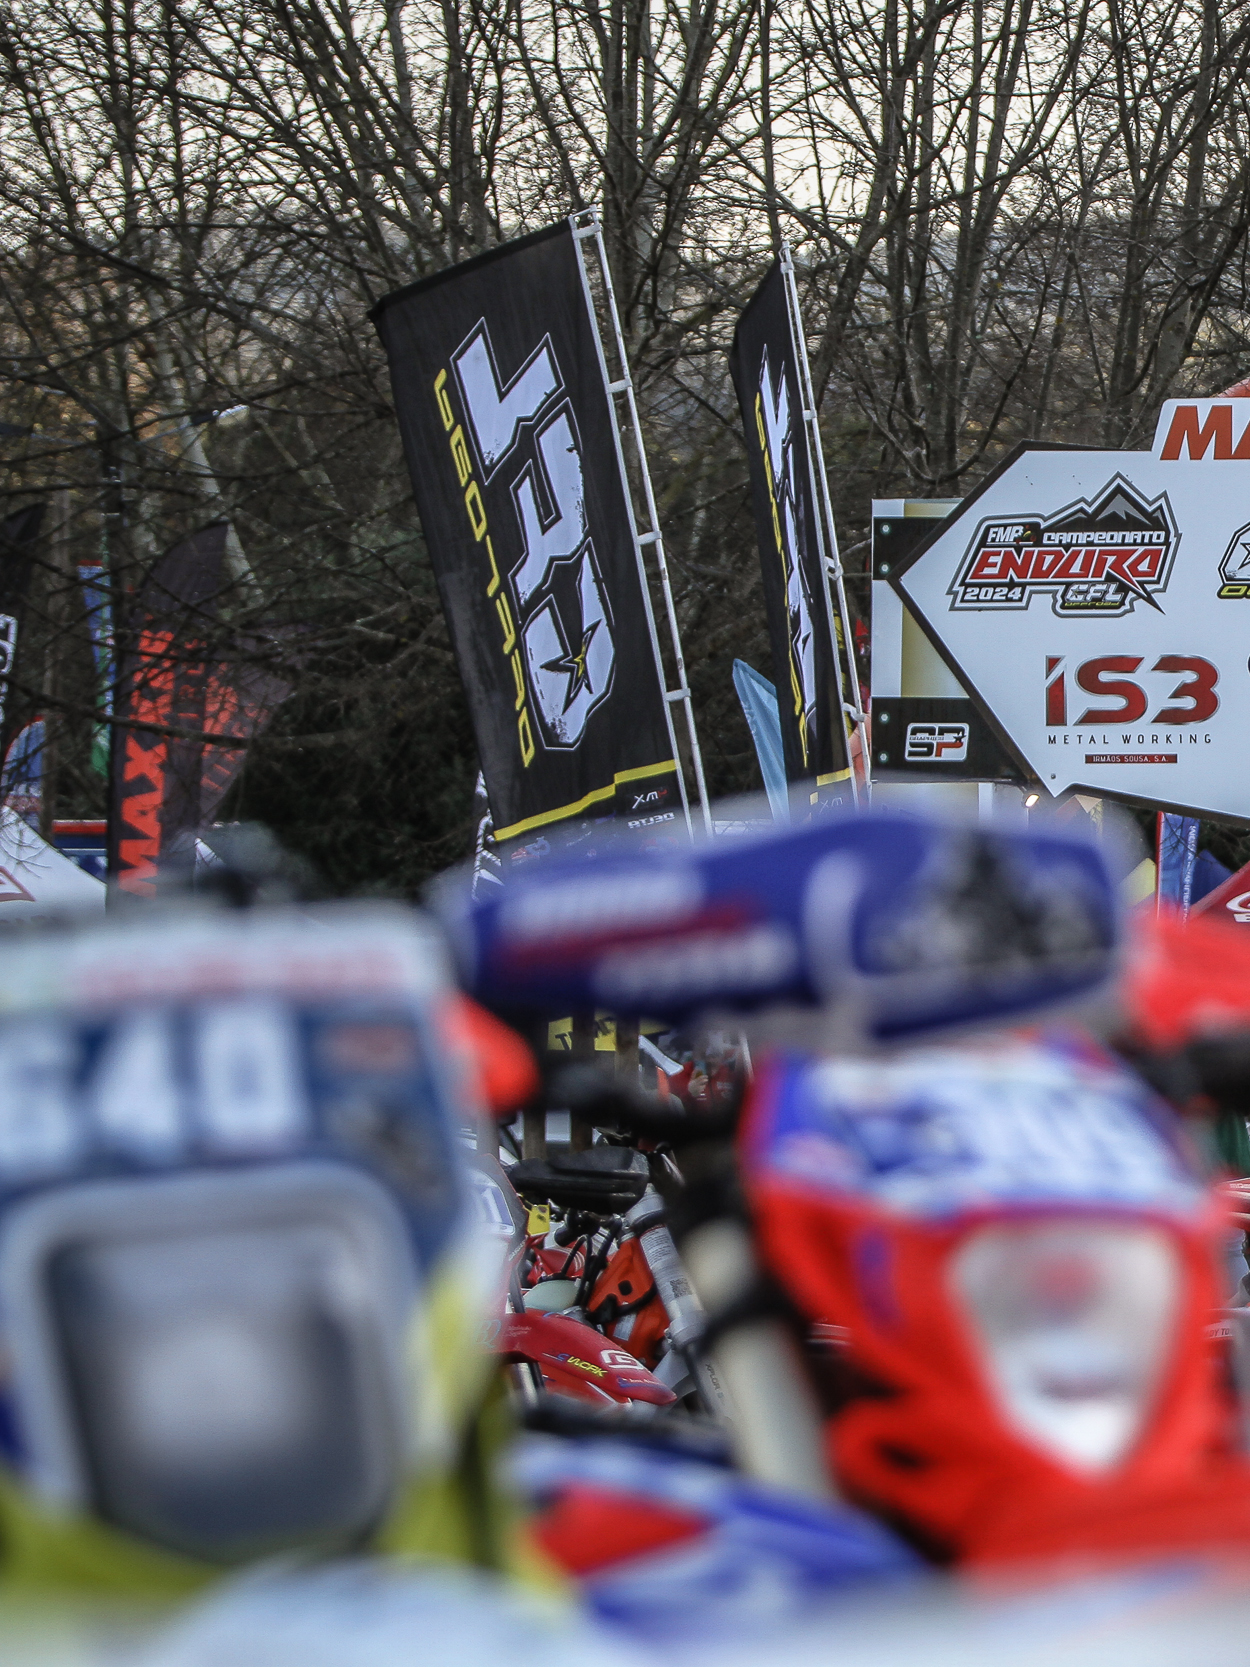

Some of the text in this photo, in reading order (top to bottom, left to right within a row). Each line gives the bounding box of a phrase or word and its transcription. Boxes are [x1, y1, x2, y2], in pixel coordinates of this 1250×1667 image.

[967, 547, 1167, 592] ENDURO
[963, 587, 1022, 601] 2024
[1048, 734, 1212, 744] METAL WORKING
[1092, 754, 1121, 763] IRMÃOS
